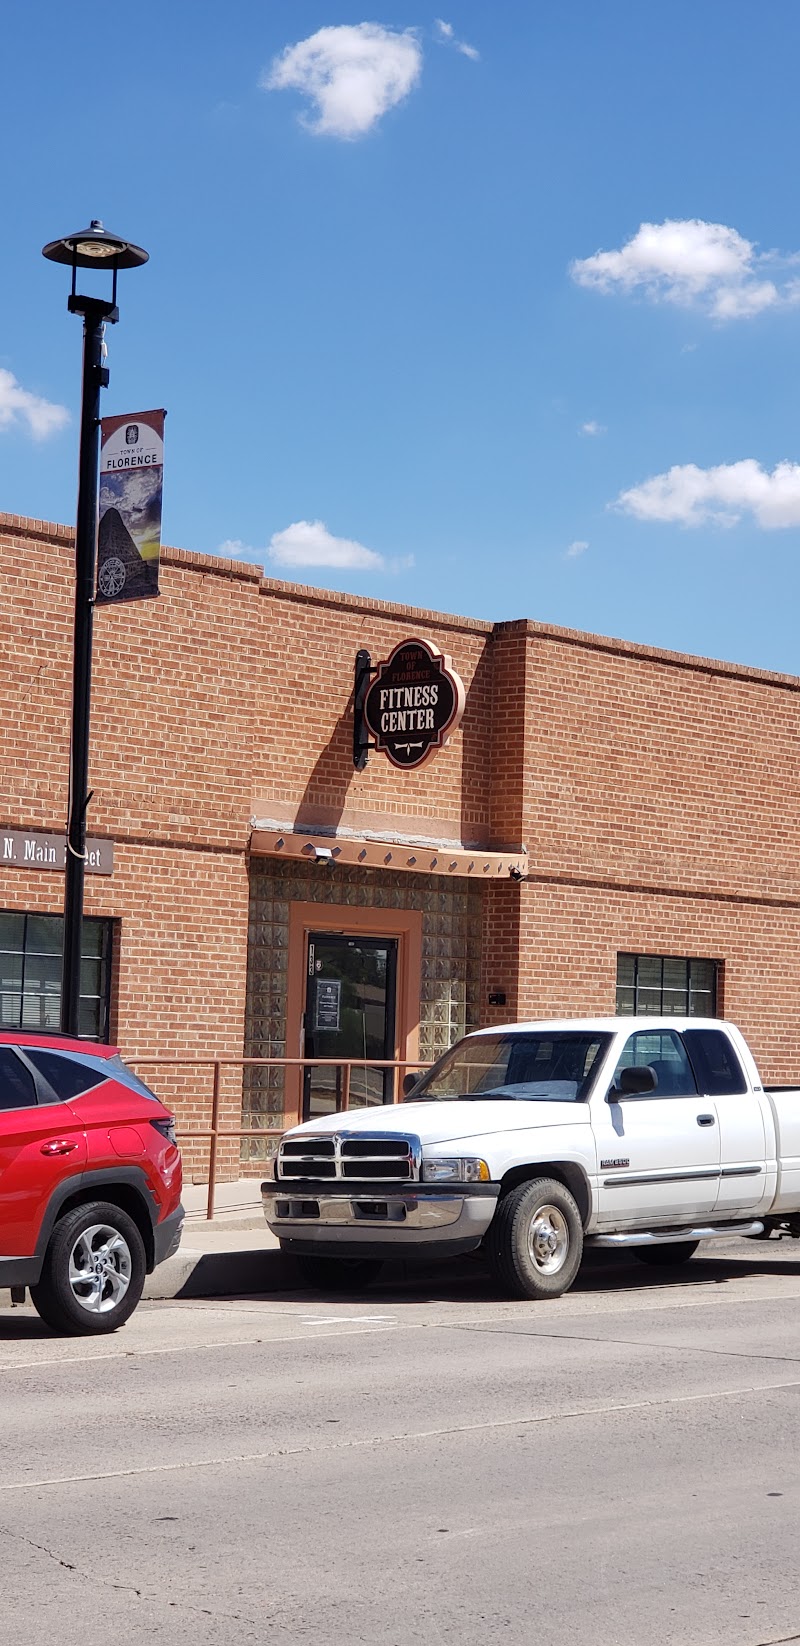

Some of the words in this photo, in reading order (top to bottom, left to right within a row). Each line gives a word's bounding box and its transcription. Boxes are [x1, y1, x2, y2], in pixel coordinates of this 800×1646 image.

[106, 454, 158, 469] FLORENCE
[400, 651, 423, 661] TOWN
[406, 661, 417, 671] OF
[392, 670, 431, 682] FLORENCE
[379, 685, 439, 710] FITNESS
[381, 708, 435, 733] CENTER
[3, 837, 17, 860] N.
[24, 839, 57, 863] Main
